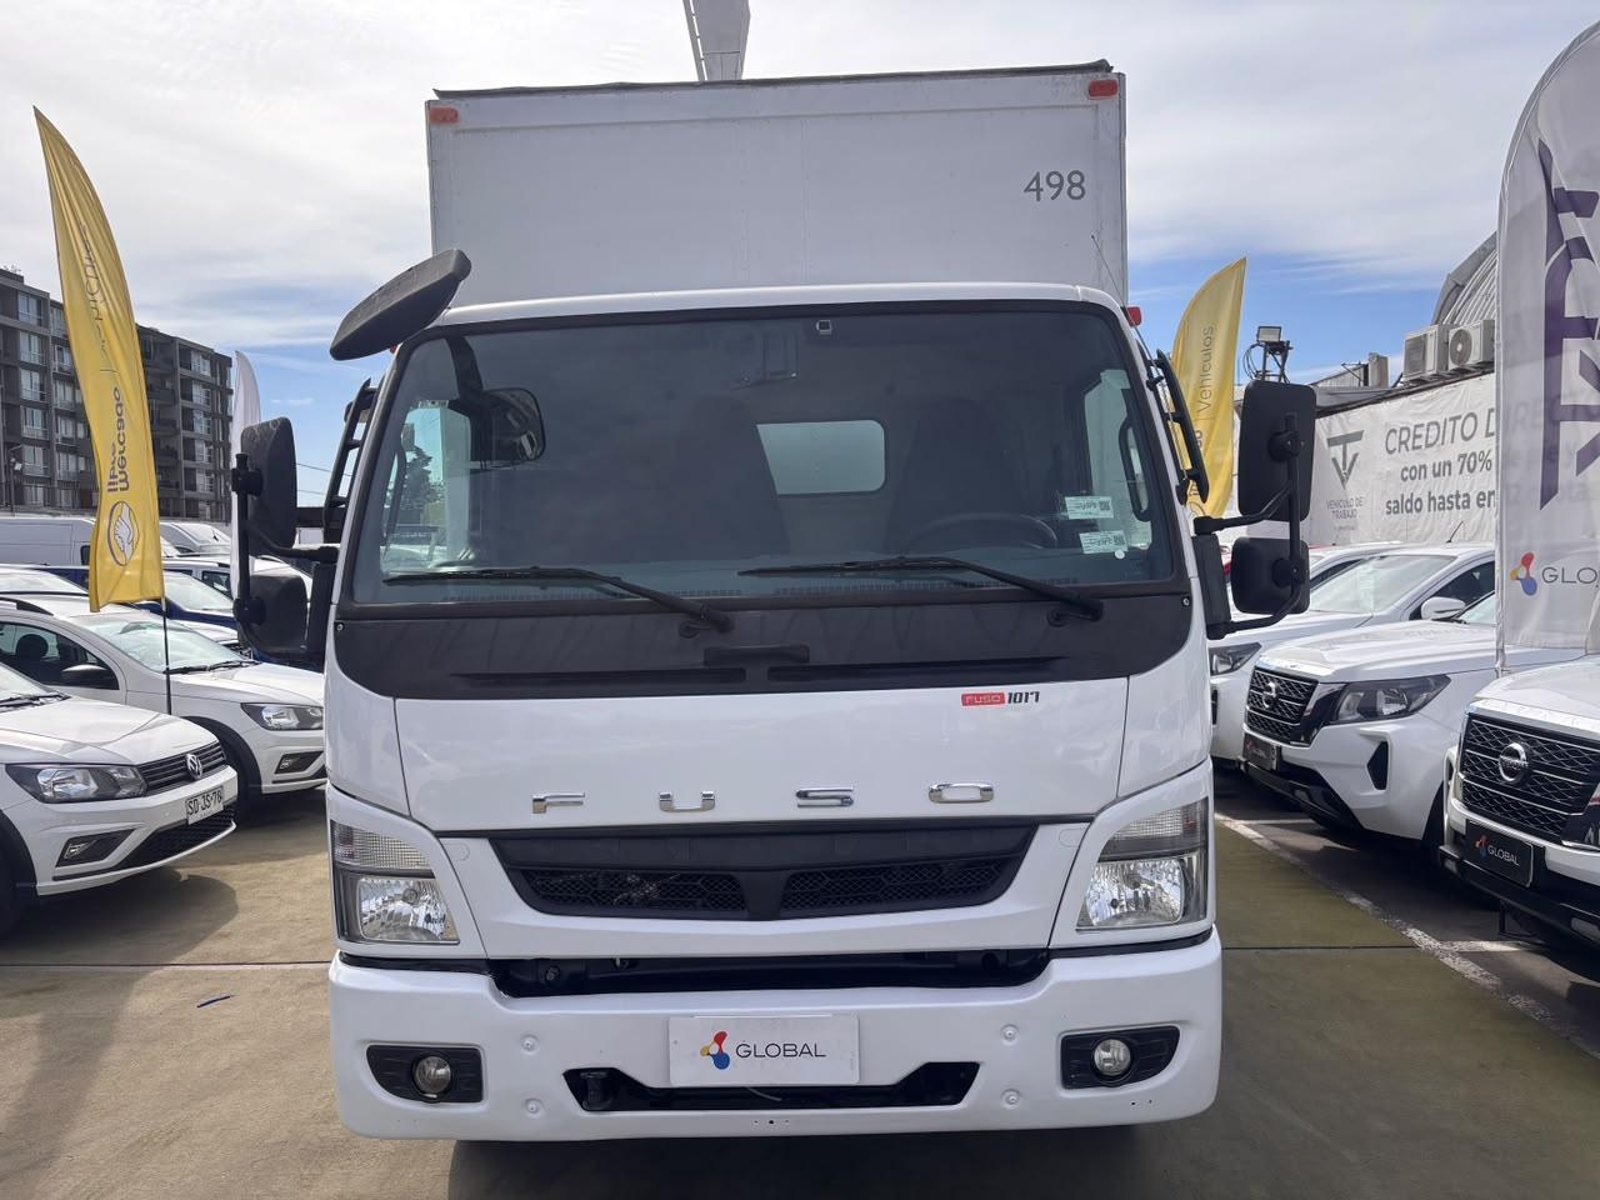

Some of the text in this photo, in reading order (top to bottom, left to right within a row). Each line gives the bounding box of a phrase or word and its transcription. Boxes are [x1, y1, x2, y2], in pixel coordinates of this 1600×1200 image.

[1023, 169, 1086, 202] 498
[1385, 412, 1478, 455] CREDITO
[1400, 464, 1427, 482] con
[1432, 460, 1452, 479] un
[1457, 449, 1492, 475] 70%
[1385, 492, 1423, 515] saldo
[1427, 490, 1471, 512] hasta
[964, 692, 1002, 704] FUSO
[532, 783, 994, 814] FUSO
[1487, 844, 1520, 866] GLOBAL
[735, 1043, 827, 1058] GLOBAL
